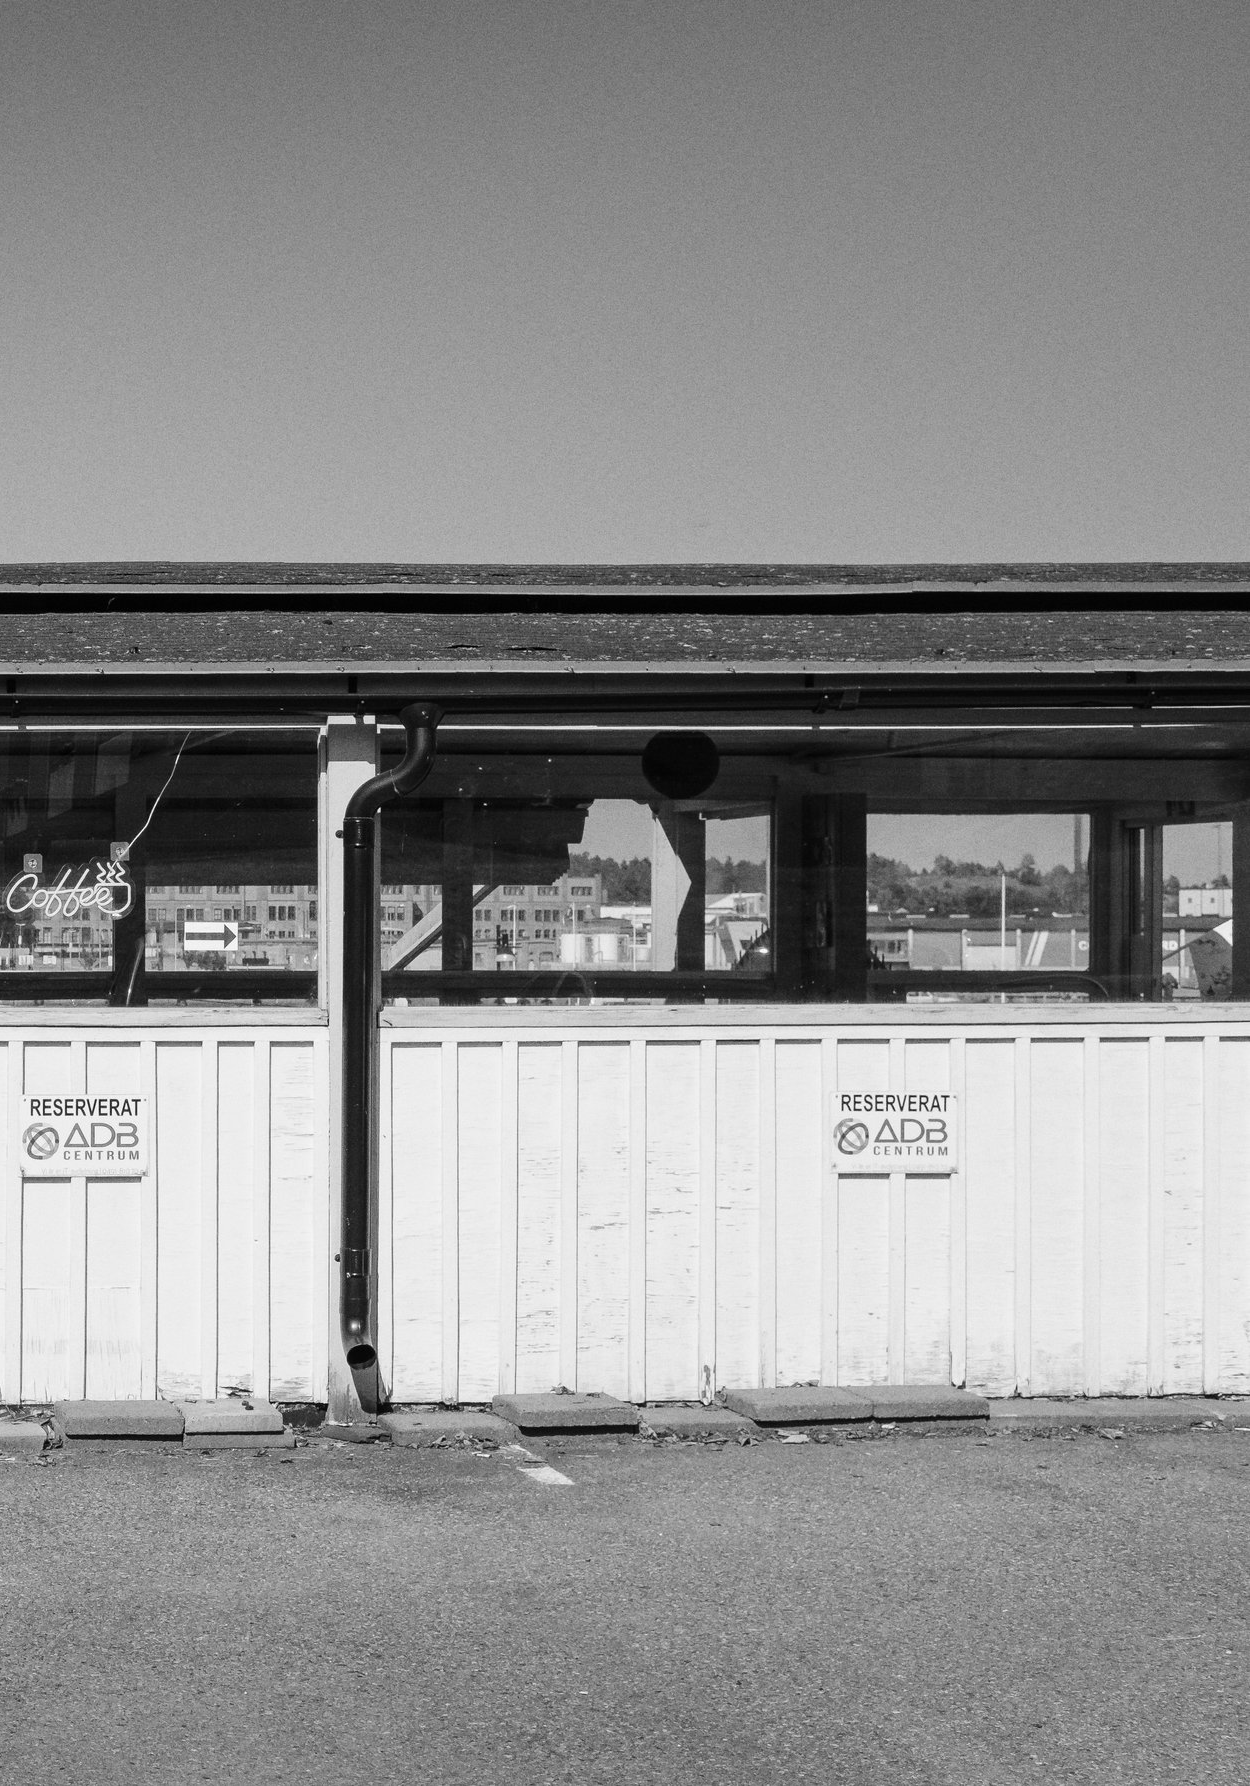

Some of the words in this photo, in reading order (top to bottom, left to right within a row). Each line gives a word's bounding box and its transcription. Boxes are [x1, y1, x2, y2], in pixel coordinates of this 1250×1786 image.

[6, 867, 114, 917] Coffee
[30, 1098, 142, 1116] RESERVERAT
[841, 1094, 950, 1112] RESERVERAT
[63, 1122, 140, 1148] ADB
[873, 1118, 948, 1143] ADB
[63, 1150, 140, 1161] CENTRUM
[873, 1145, 948, 1156] CENTRUM
